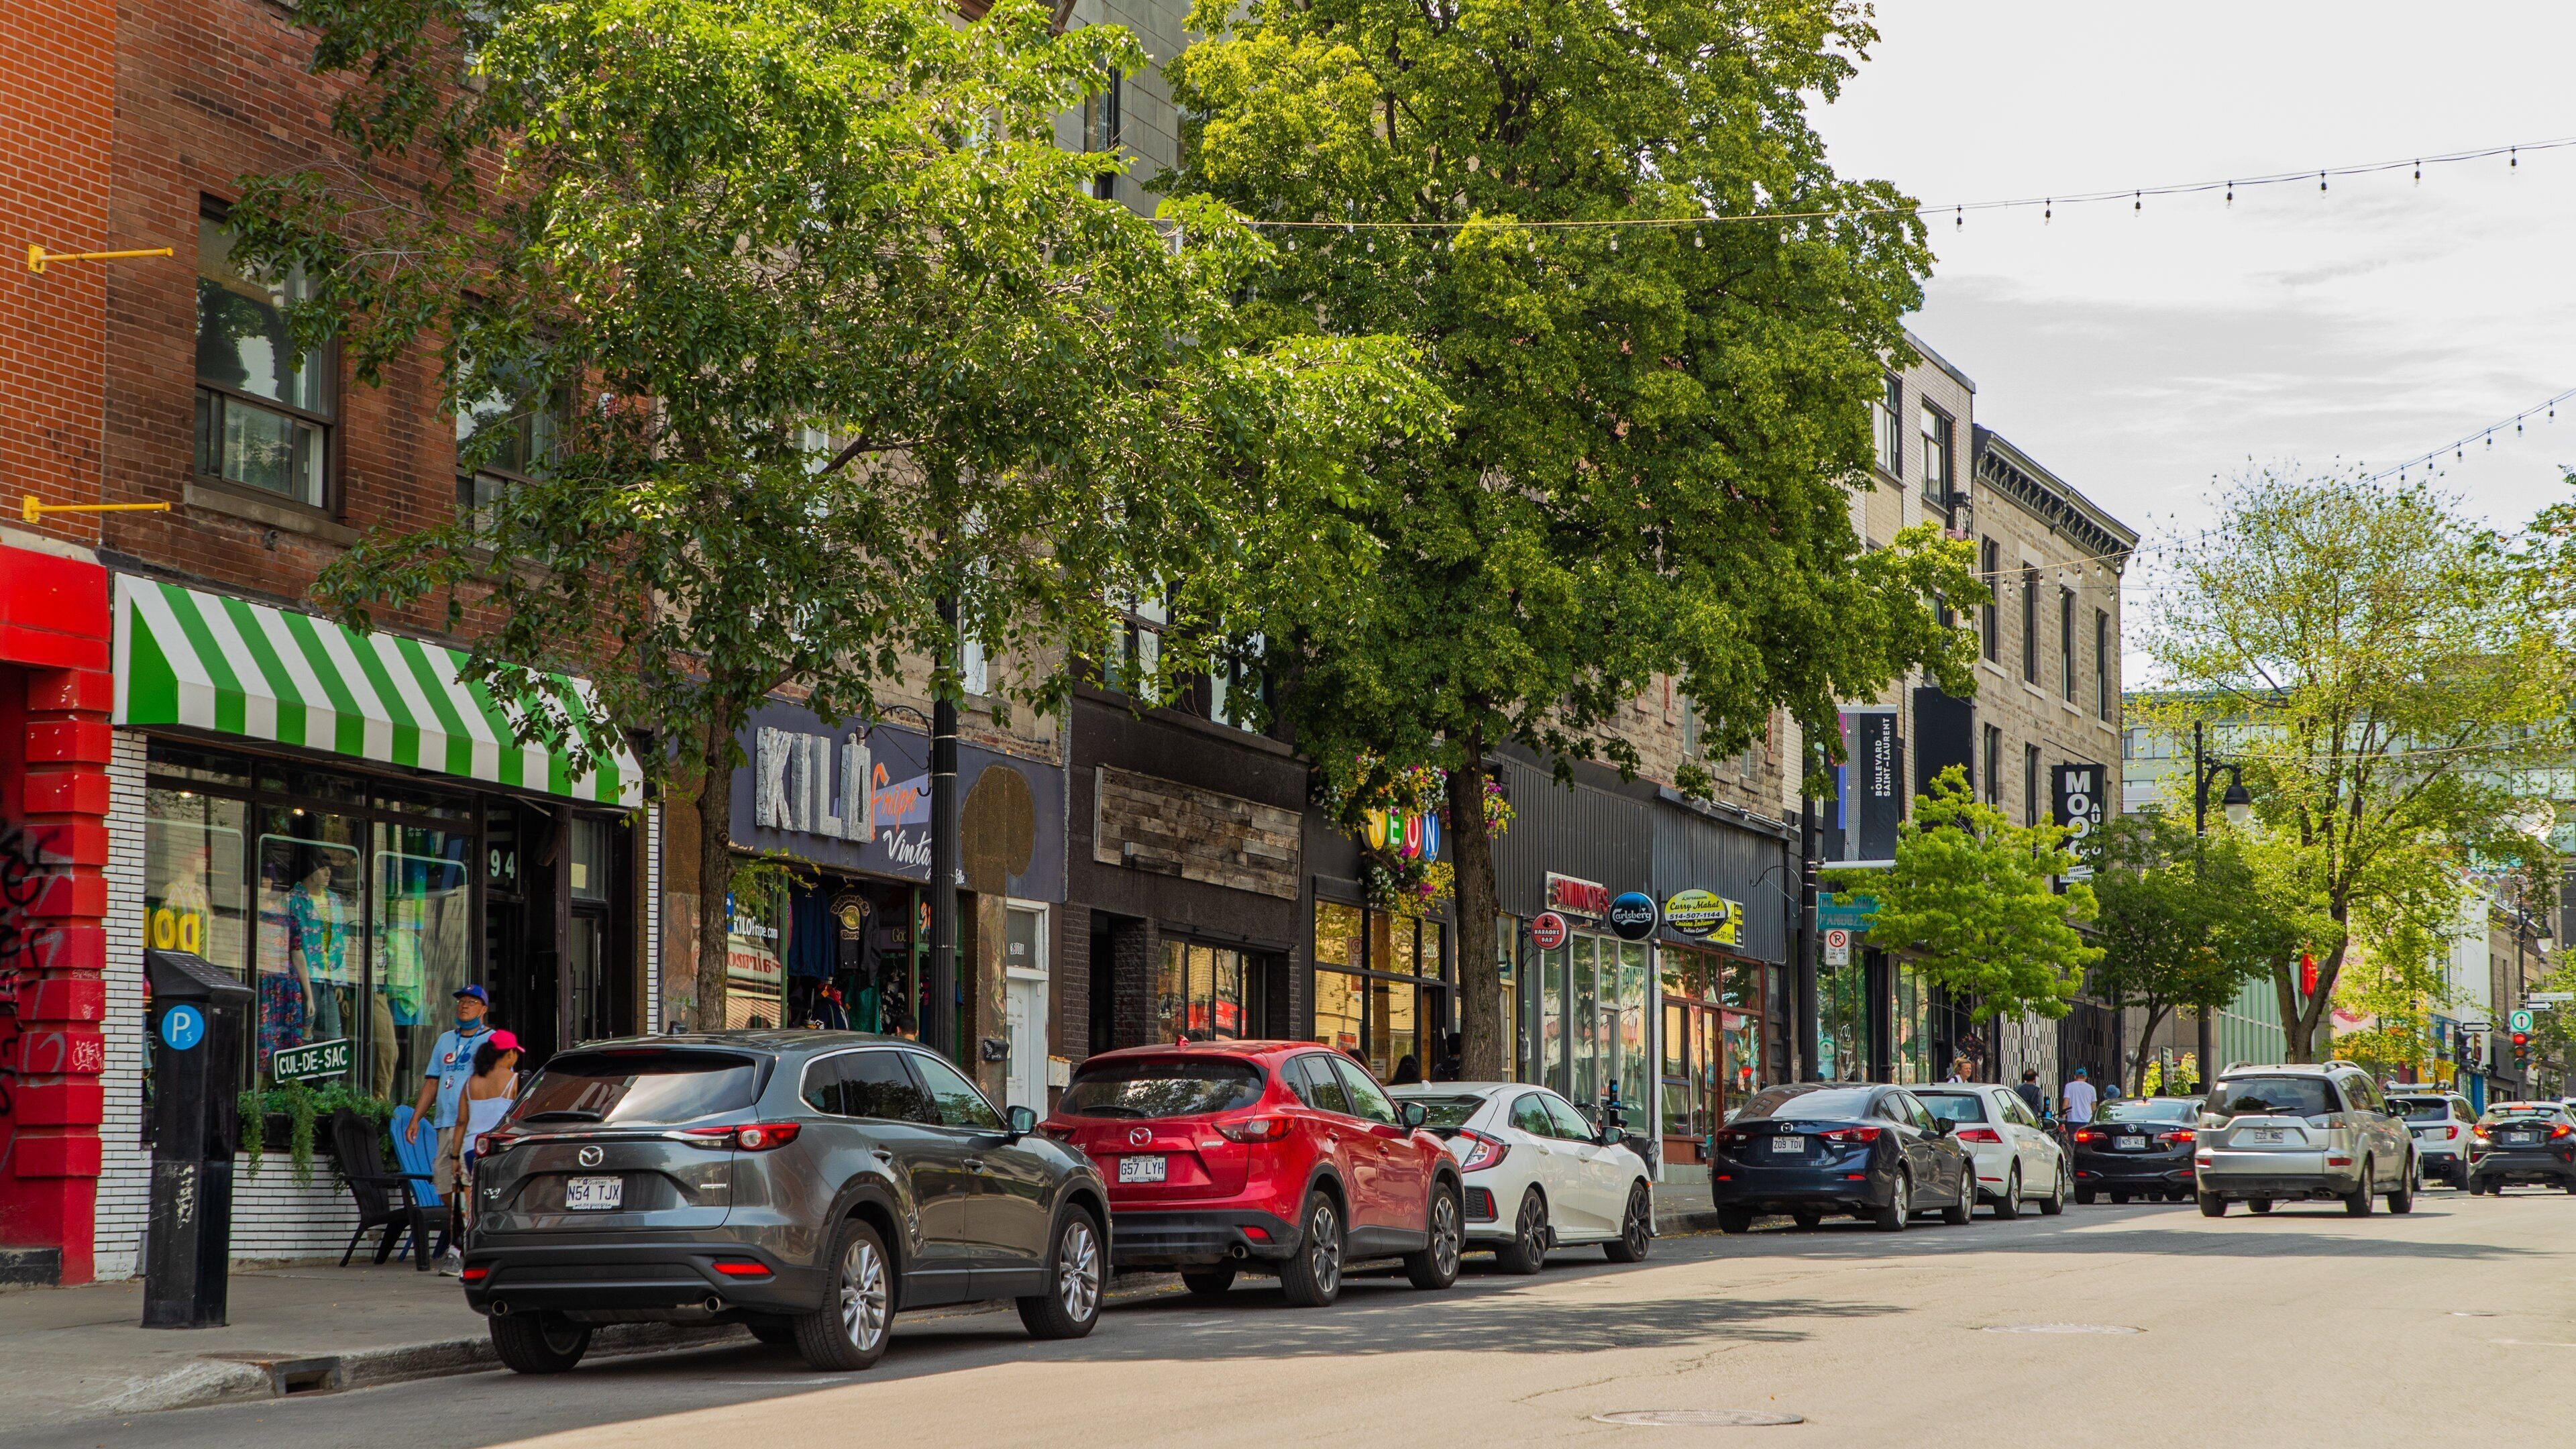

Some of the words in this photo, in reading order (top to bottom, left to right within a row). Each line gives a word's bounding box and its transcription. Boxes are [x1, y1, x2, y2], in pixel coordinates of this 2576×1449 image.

[1883, 717, 1891, 797] SAINT-LAURENT
[756, 727, 872, 844] KILO
[490, 849, 515, 879] 94
[1670, 902, 1691, 911] Curry
[1693, 900, 1719, 910] Mahal
[1612, 908, 1652, 925] Carlsberg
[1670, 912, 1720, 920] 514-507-1144
[278, 1045, 348, 1075] CUL-DE-SAC
[1774, 1140, 1786, 1148] Z09
[1121, 1163, 1139, 1175] G57
[1145, 1162, 1164, 1175] LYH
[568, 1185, 590, 1201] N54
[598, 1185, 620, 1200] TJX
